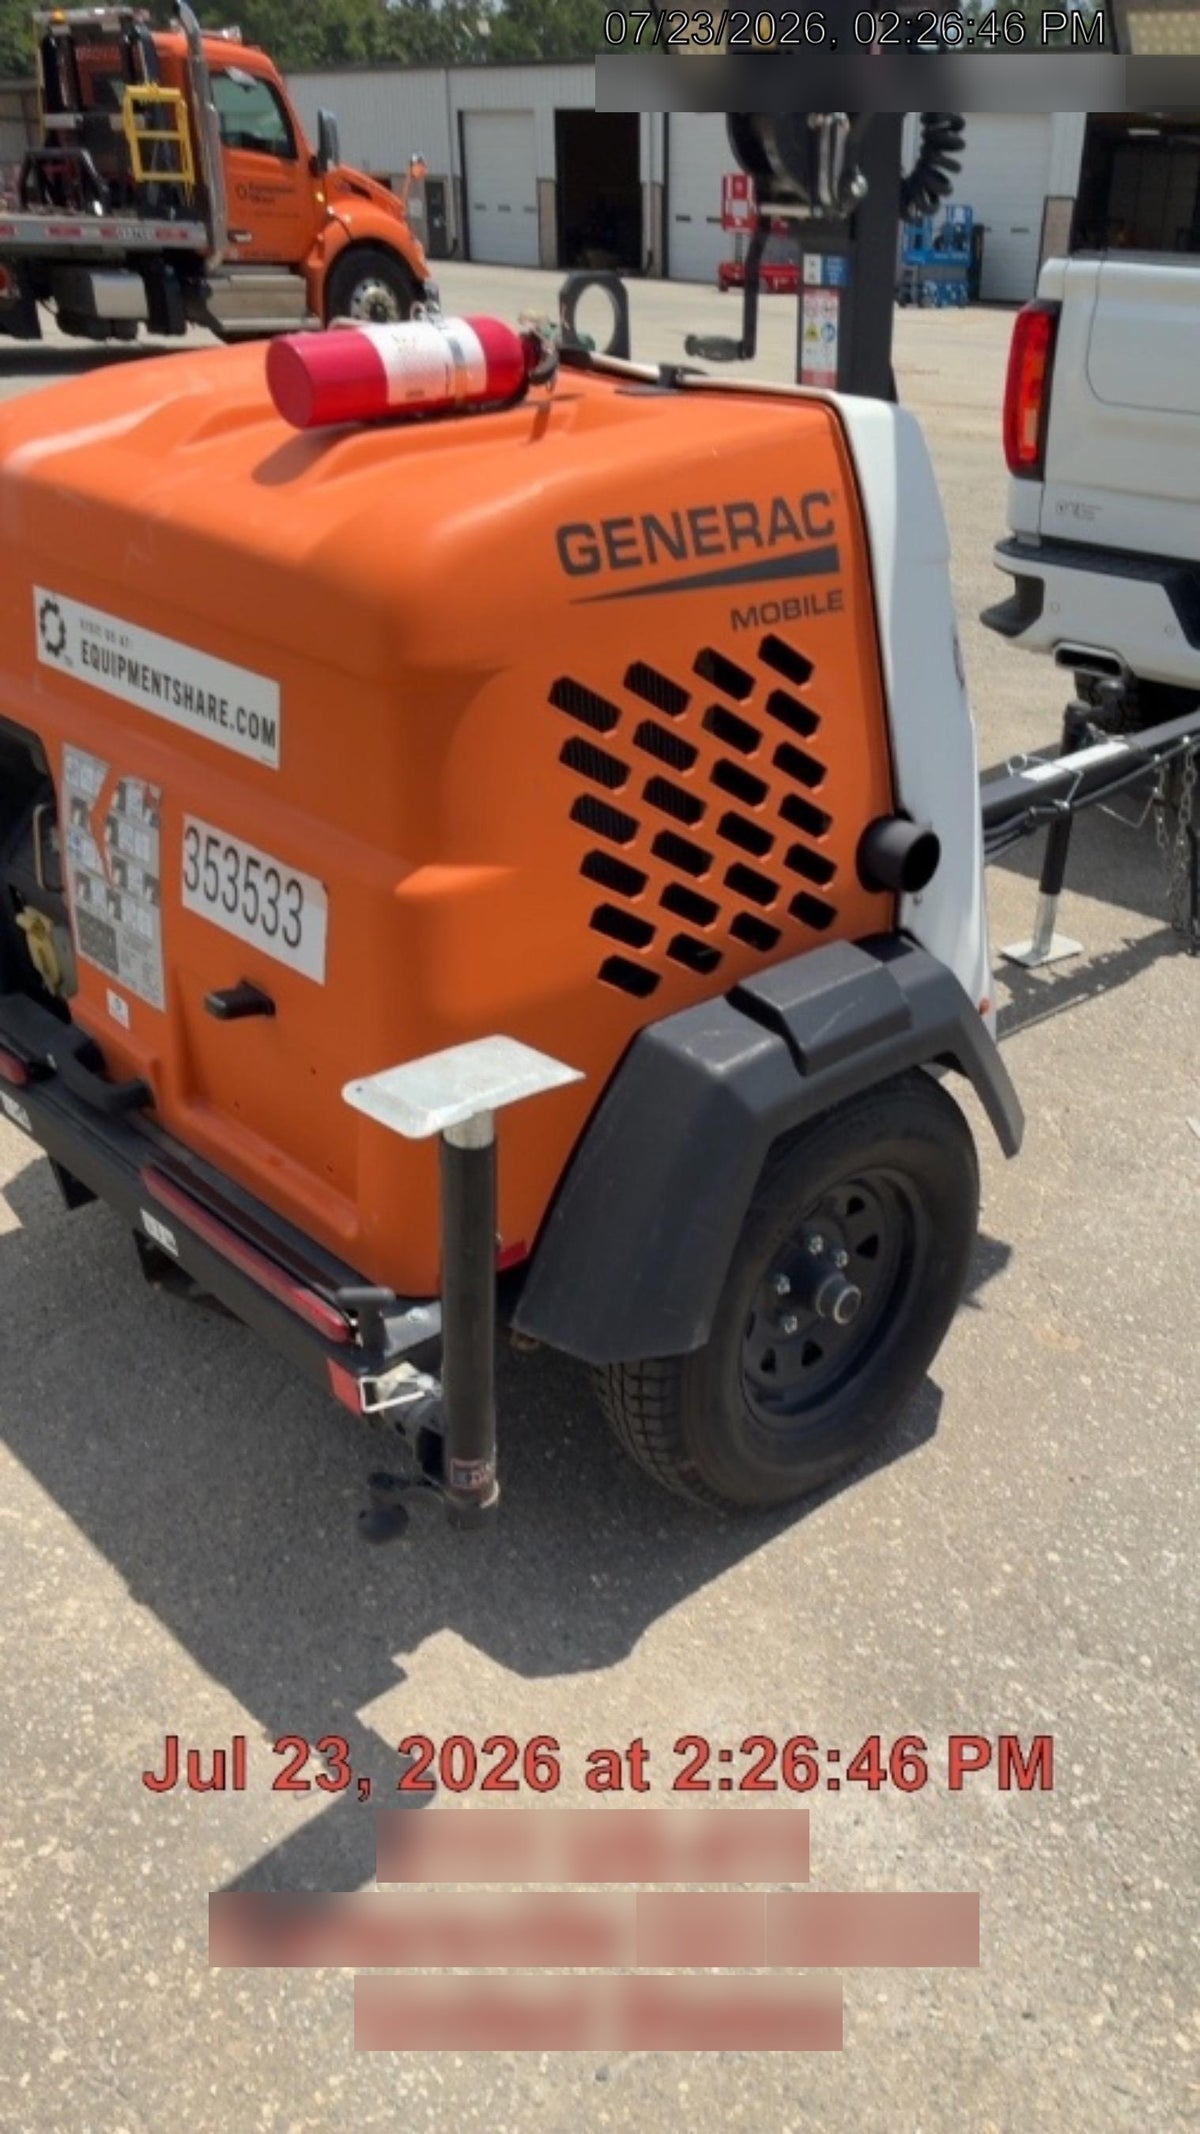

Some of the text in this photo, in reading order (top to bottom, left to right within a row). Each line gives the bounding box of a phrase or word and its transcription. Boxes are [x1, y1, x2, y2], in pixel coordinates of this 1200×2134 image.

[555, 491, 835, 577] GENERAC
[730, 589, 844, 631] MOBILE
[80, 638, 277, 749] EQUIPMENTSHARE.COM
[184, 825, 304, 949] 353533
